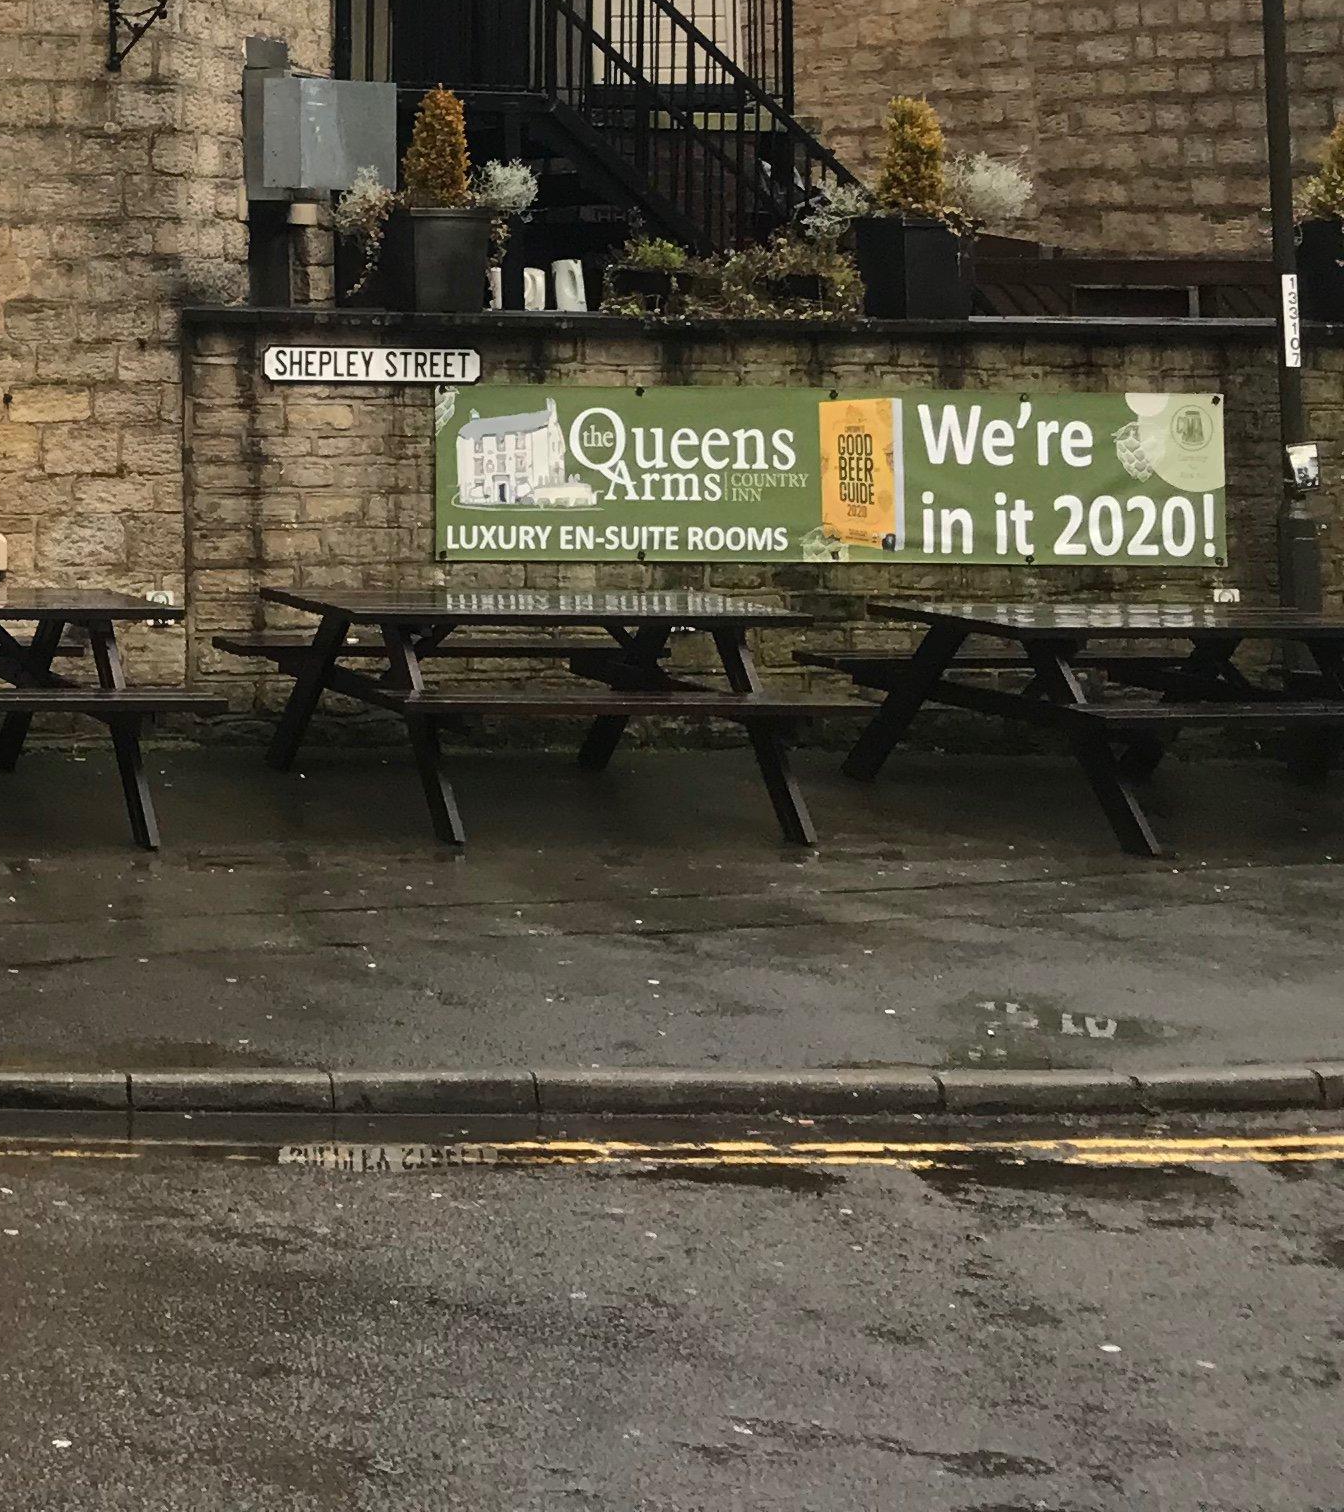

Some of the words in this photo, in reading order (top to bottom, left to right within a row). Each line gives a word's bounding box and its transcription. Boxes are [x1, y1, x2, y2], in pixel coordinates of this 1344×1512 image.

[275, 349, 374, 378] SHEPLEY
[384, 351, 471, 378] STREET
[569, 407, 797, 485] Queens
[582, 424, 615, 448] the
[837, 433, 873, 457] GOOD
[917, 402, 1094, 467] We're
[603, 459, 723, 502] Arms
[730, 473, 809, 489] COUNTRY
[838, 456, 874, 483] BEER
[731, 488, 763, 502] INN
[839, 481, 875, 505] GUIDE
[846, 504, 868, 518] 2020
[922, 491, 974, 555] in
[994, 492, 1034, 556] it
[1053, 493, 1215, 558] 2020!
[446, 524, 552, 551] LUXURY
[559, 525, 679, 551] EN-SUITE
[687, 526, 789, 552] ROOMS
